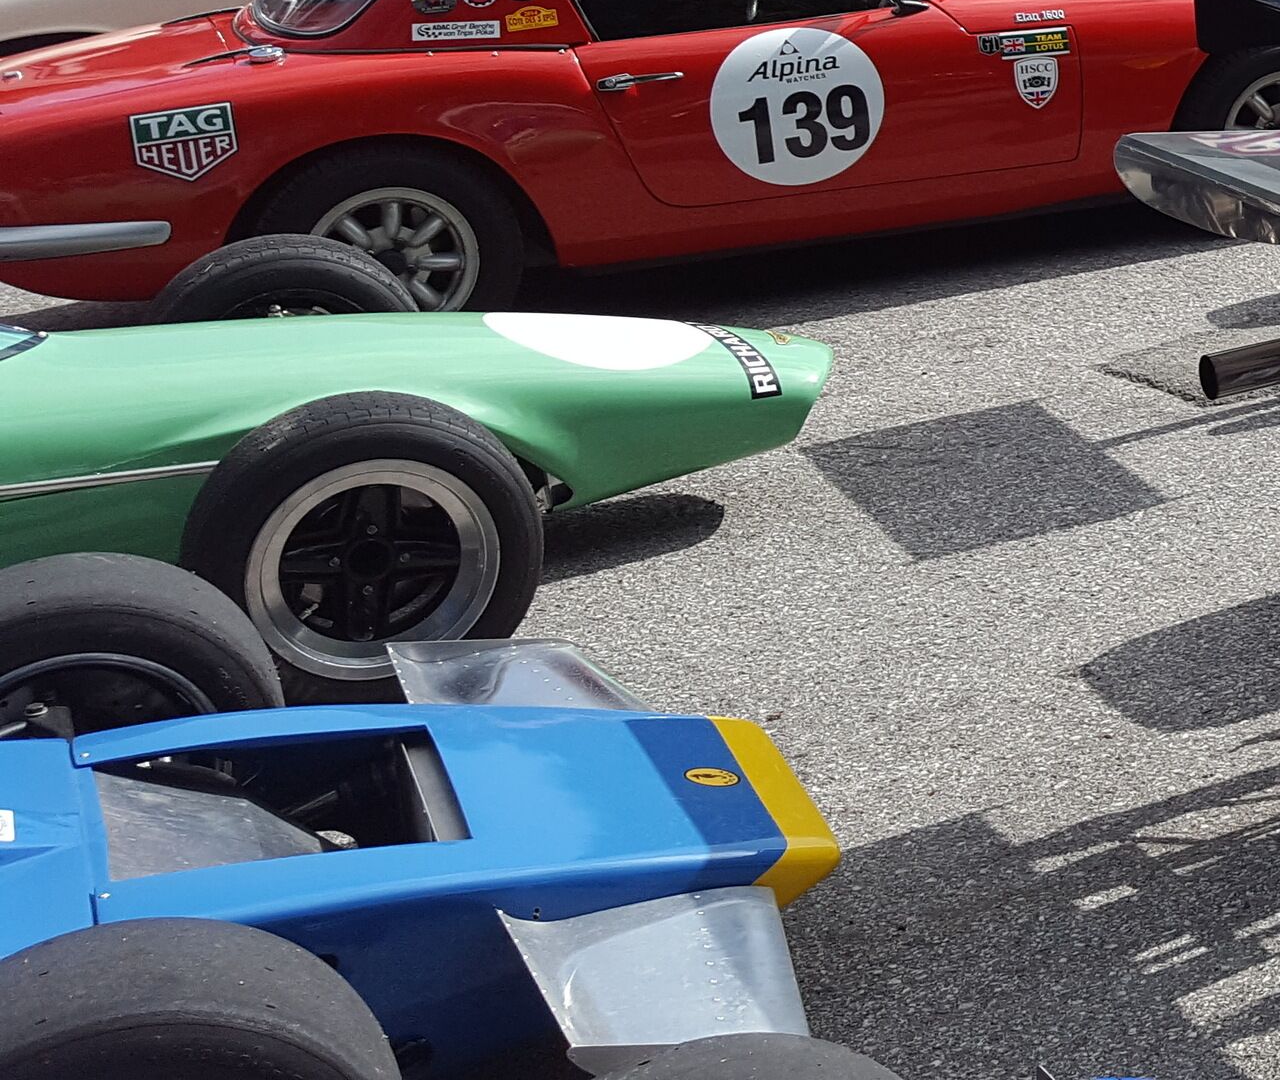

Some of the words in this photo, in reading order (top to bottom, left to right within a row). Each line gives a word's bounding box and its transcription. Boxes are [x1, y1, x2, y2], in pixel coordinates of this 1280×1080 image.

[1015, 12, 1040, 22] Elan
[1041, 10, 1065, 19] 1600
[980, 35, 999, 51] GT
[1036, 43, 1064, 51] LOTUS
[747, 54, 841, 82] Alpina
[1020, 63, 1052, 74] HSCC
[785, 72, 827, 84] WATCHES
[141, 107, 224, 139] TAG
[738, 84, 871, 164] 139
[141, 133, 235, 177] HEUER
